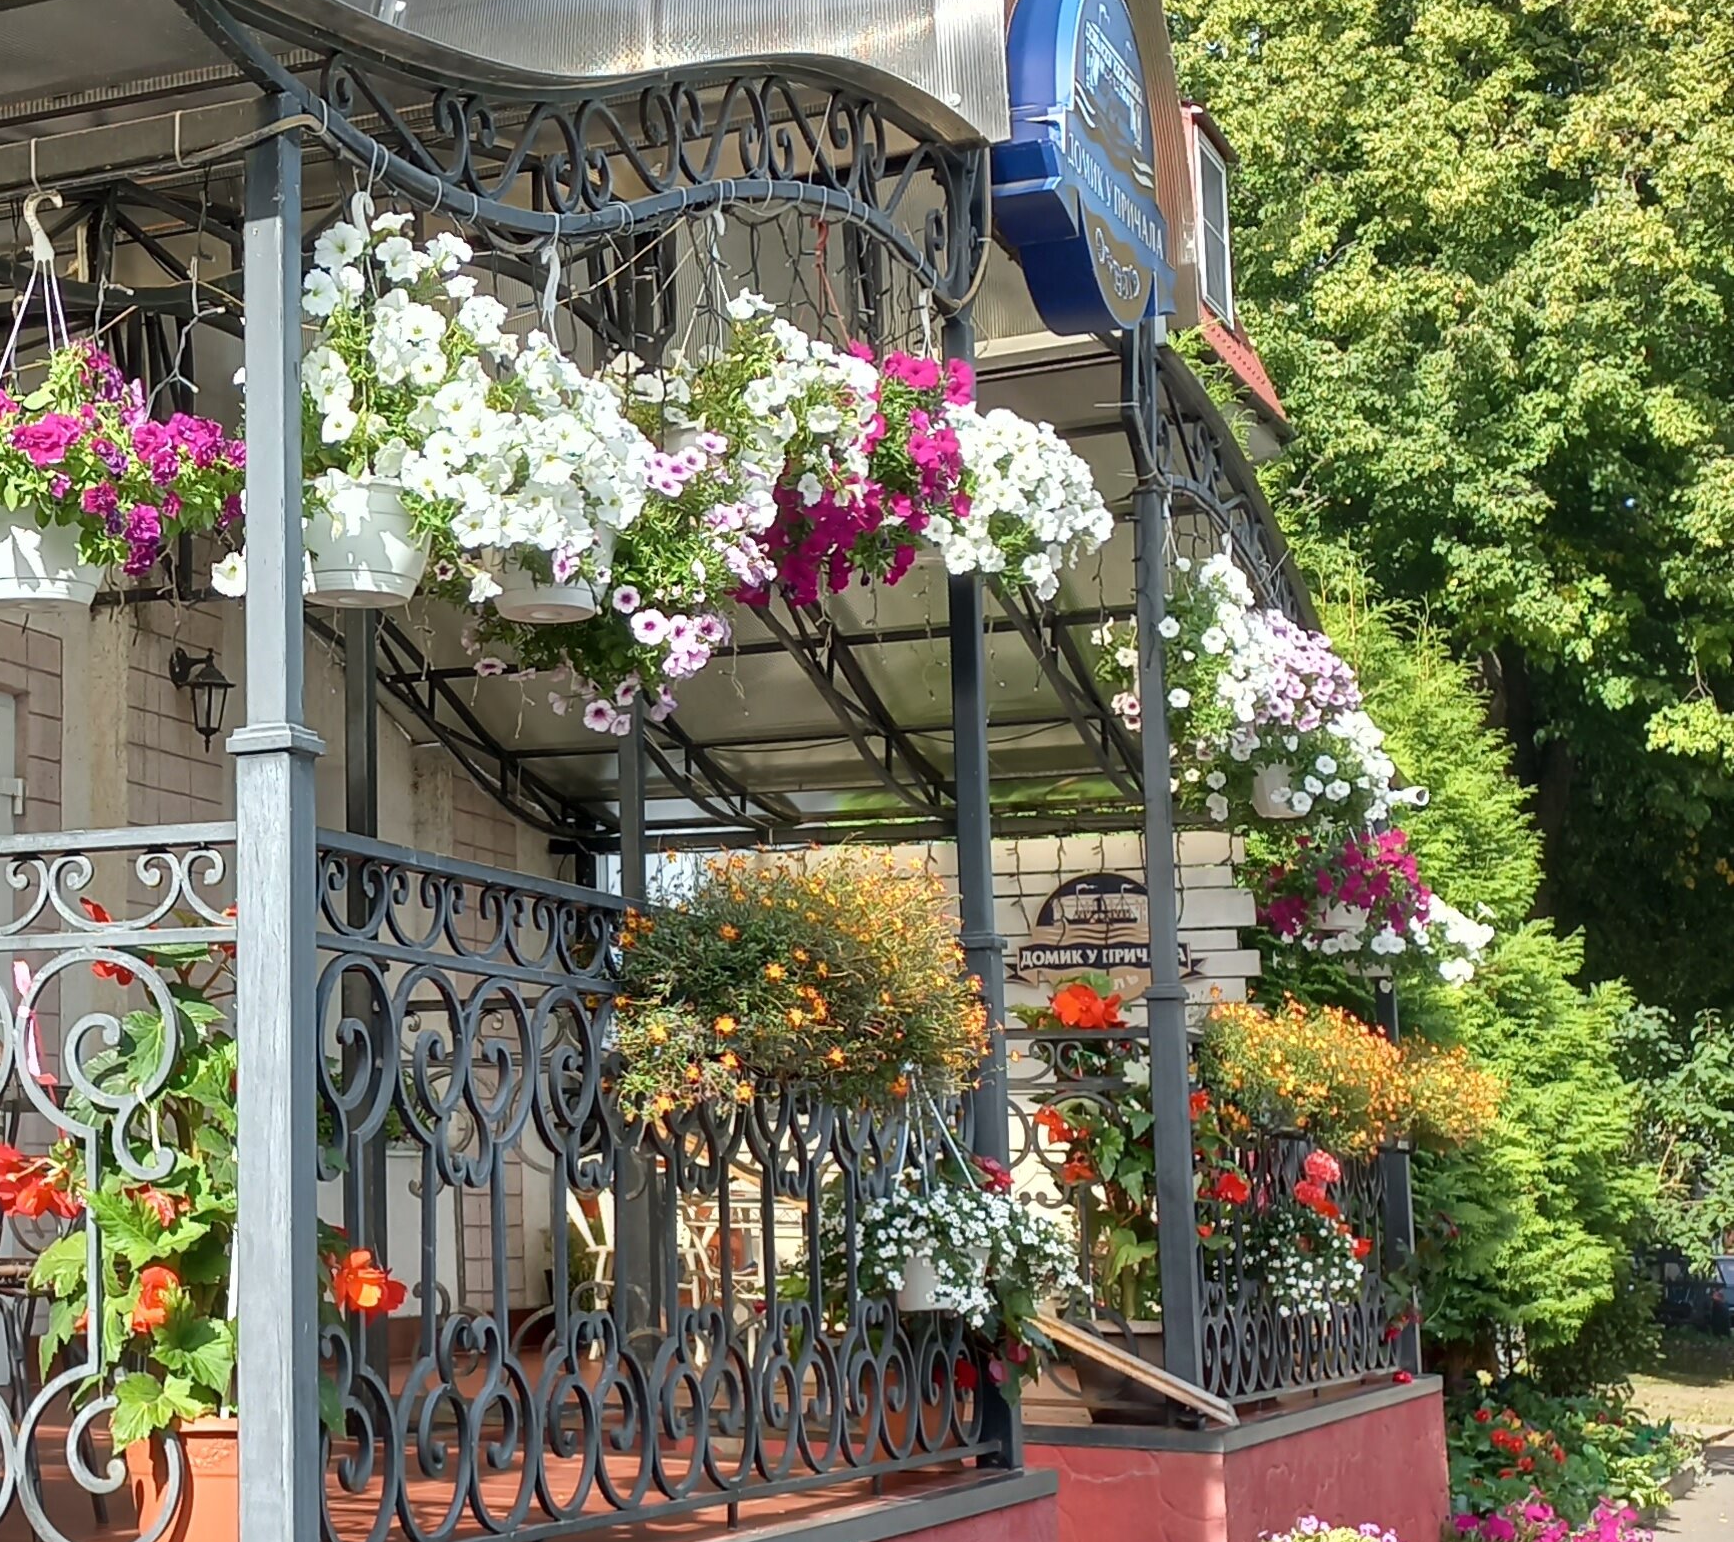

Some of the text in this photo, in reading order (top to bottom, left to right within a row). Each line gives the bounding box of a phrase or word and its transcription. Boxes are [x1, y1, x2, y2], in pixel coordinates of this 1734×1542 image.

[1067, 132, 1105, 202] ДОМИК
[1114, 185, 1164, 259] ПРИЧАЛА
[1020, 947, 1187, 968] ДОМИК У ПРИЧА
